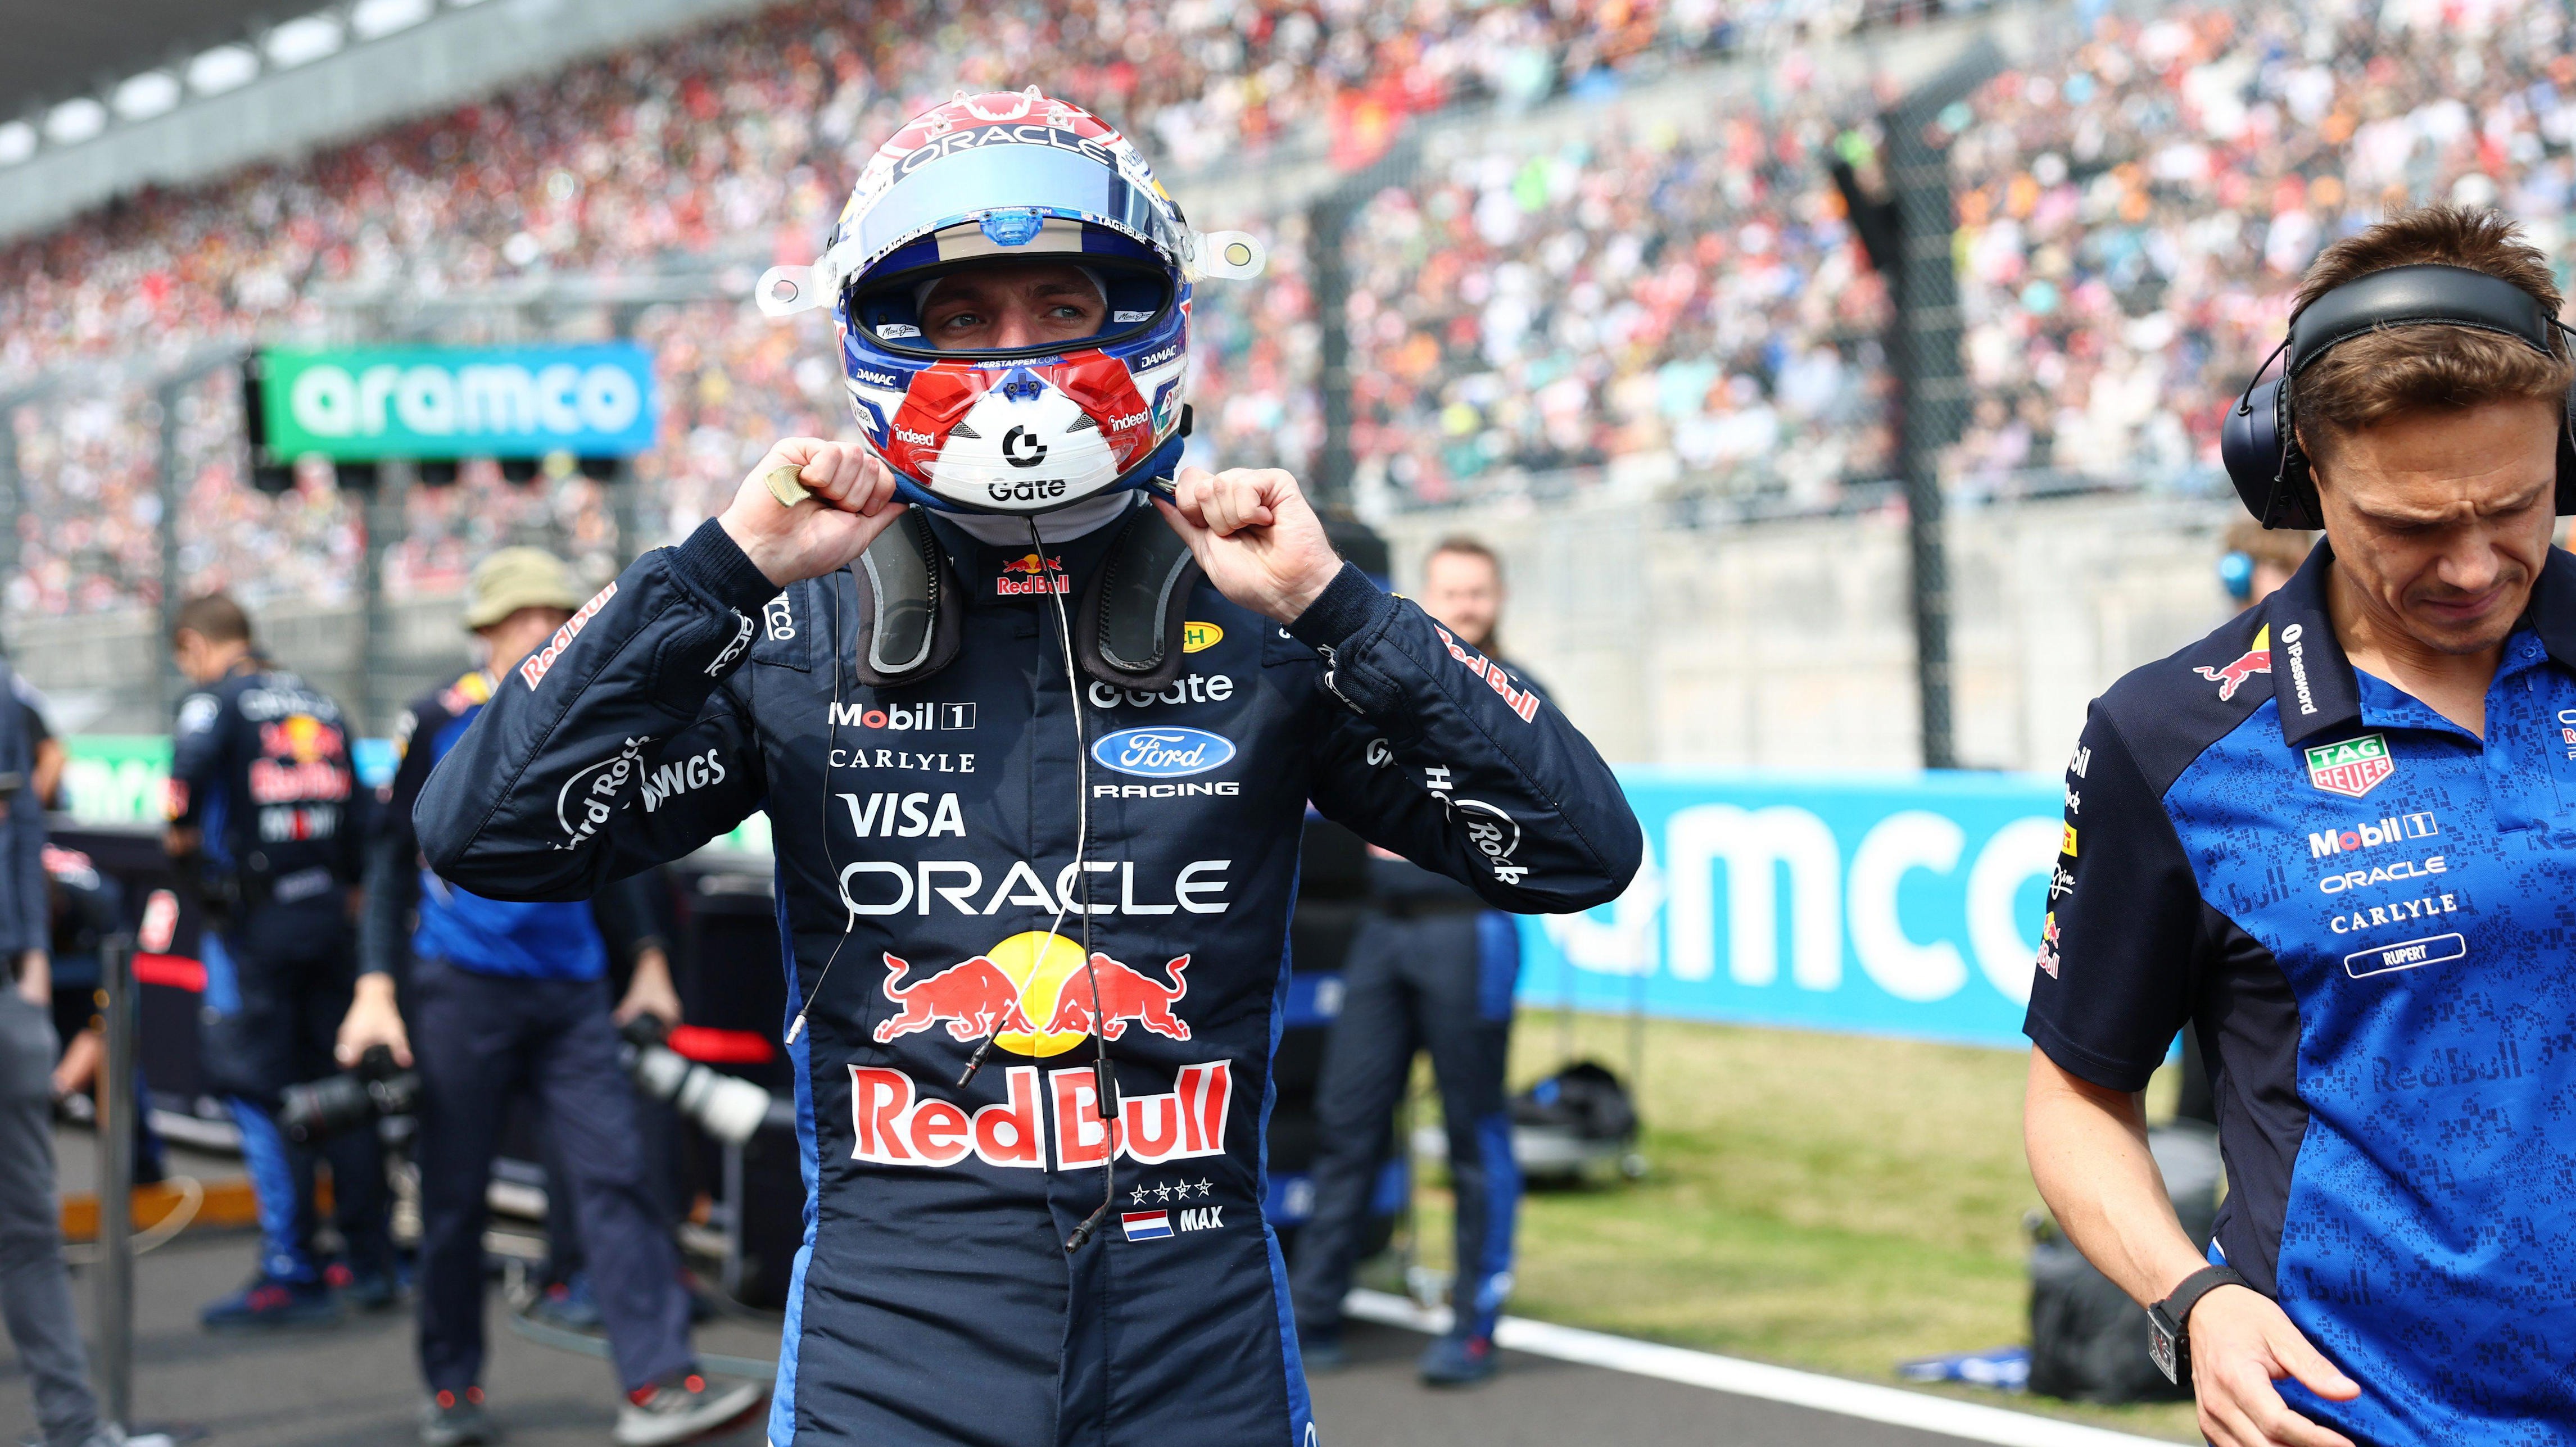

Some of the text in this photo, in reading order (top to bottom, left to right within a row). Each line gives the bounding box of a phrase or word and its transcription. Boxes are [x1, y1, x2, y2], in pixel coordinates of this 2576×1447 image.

[901, 125, 1110, 174] ORACLE
[977, 355, 1058, 369] VERSTAPPEN.COM
[1141, 344, 1176, 368] DAMAC
[857, 368, 896, 386] DAMAC
[291, 364, 640, 436] aramco
[893, 424, 935, 447] indeed
[1108, 407, 1148, 432] indeed
[988, 478, 1066, 501] Gate
[997, 575, 1033, 595] Red
[1486, 663, 1540, 724] Bull
[2287, 641, 2318, 715] 1Password
[828, 701, 934, 731] Mobil
[829, 749, 975, 773] CARLYLE
[1121, 734, 1207, 767] Ford
[2070, 741, 2091, 779] bil
[2312, 739, 2381, 766] TAG
[1093, 782, 1239, 799] RACING
[2316, 759, 2389, 791] HEUER
[835, 792, 966, 837] VISA
[1468, 822, 1528, 884] Rock
[2308, 817, 2402, 859] Mobil
[839, 860, 1232, 915] ORACLE
[2319, 855, 2447, 893] ORACLE
[2330, 893, 2457, 935] CARLYLE
[2382, 945, 2427, 966] RUPERT
[848, 1064, 1046, 1171] Red
[1048, 1060, 1231, 1171] Bull
[1180, 1205, 1224, 1232] MAX
